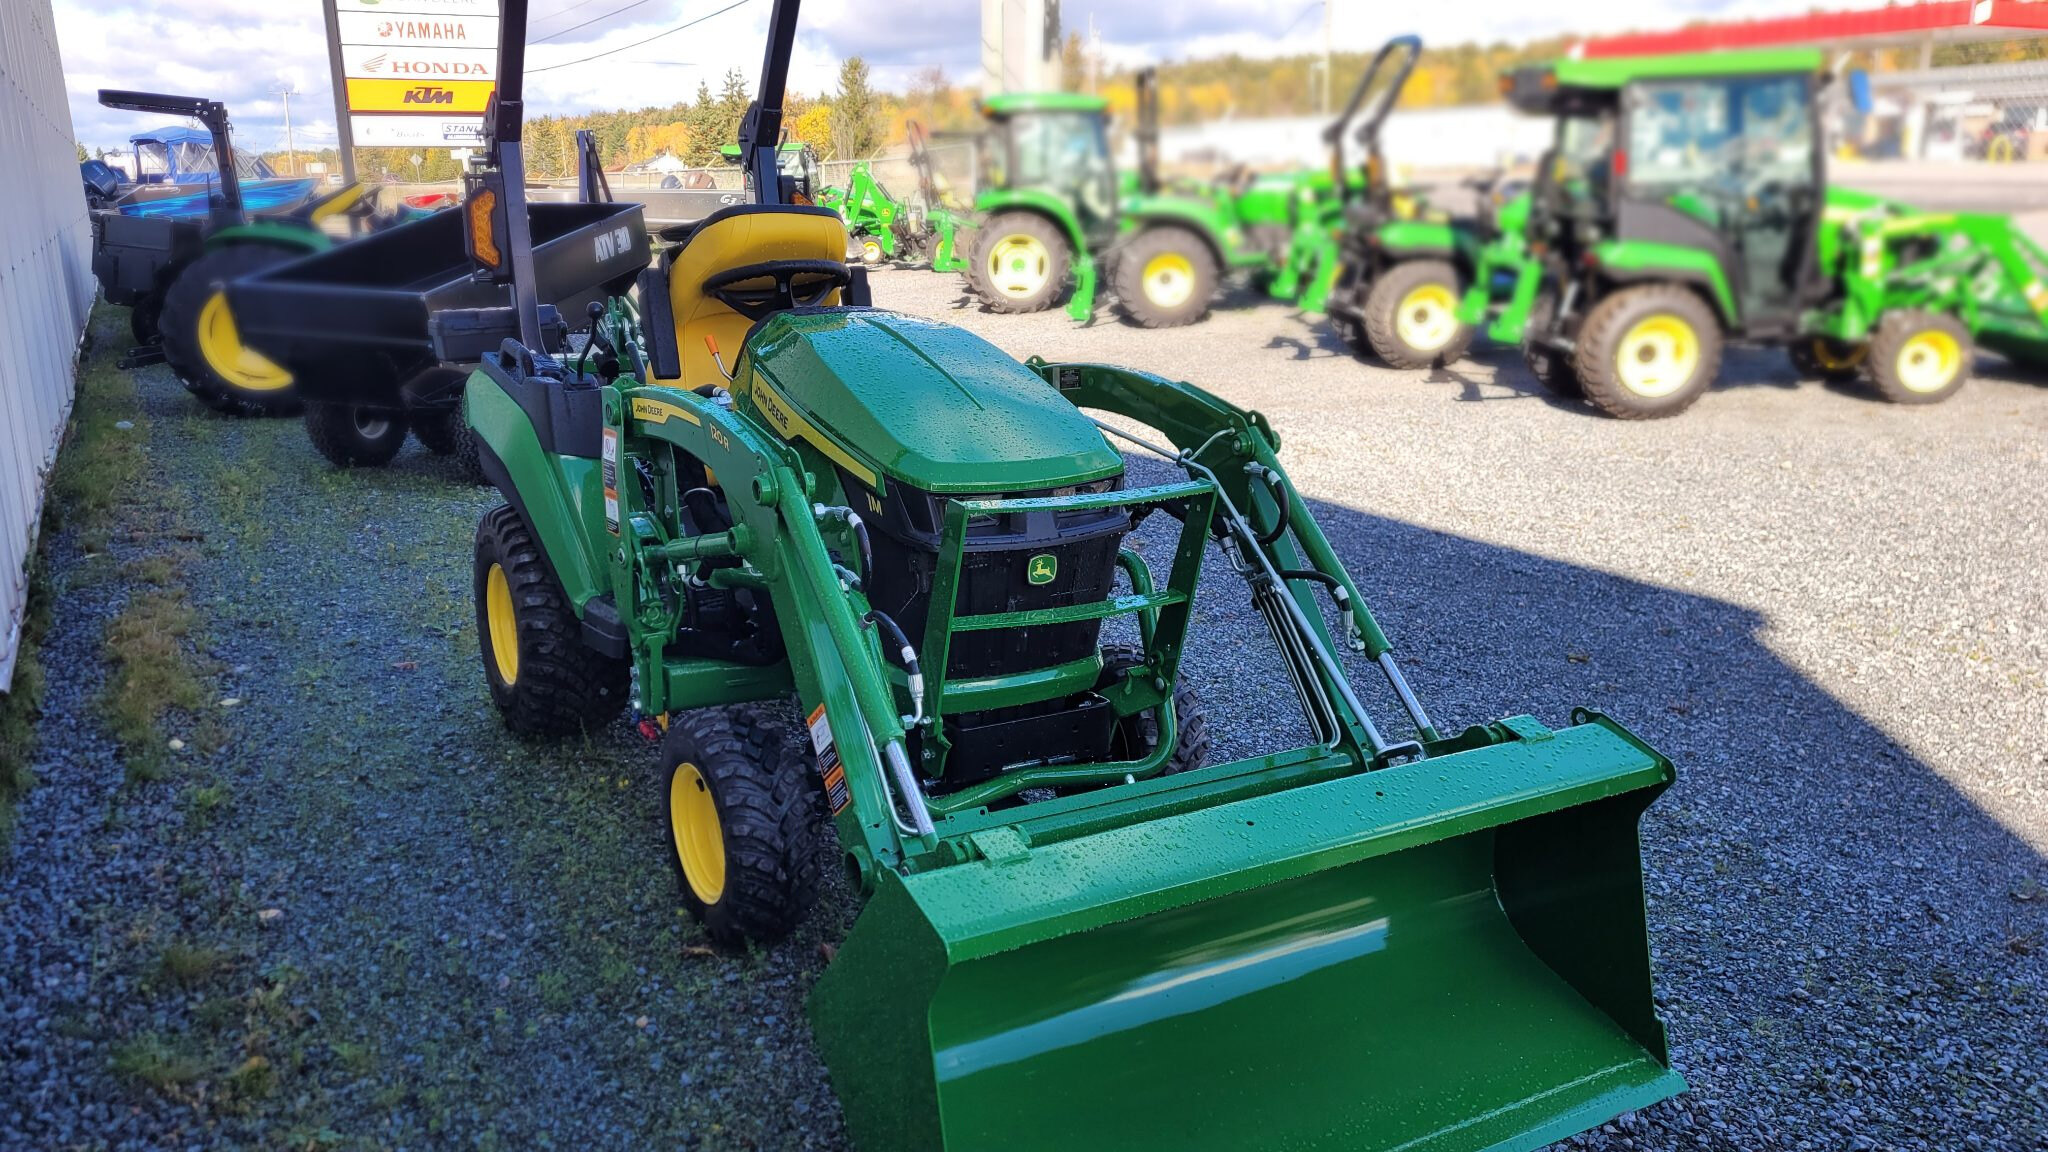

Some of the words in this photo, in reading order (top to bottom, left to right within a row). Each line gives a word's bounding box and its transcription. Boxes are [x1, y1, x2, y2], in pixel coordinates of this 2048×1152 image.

[395, 21, 466, 40] YAMAHA
[392, 61, 488, 75] HONDA
[403, 86, 454, 104] KTM
[720, 194, 737, 205] G3
[594, 231, 615, 263] ATV
[614, 226, 632, 254] 30
[635, 402, 648, 414] JOHN
[647, 404, 664, 417] DEERE
[754, 380, 768, 408] JOHN
[767, 396, 789, 430] DEERE
[865, 491, 883, 517] 1M
